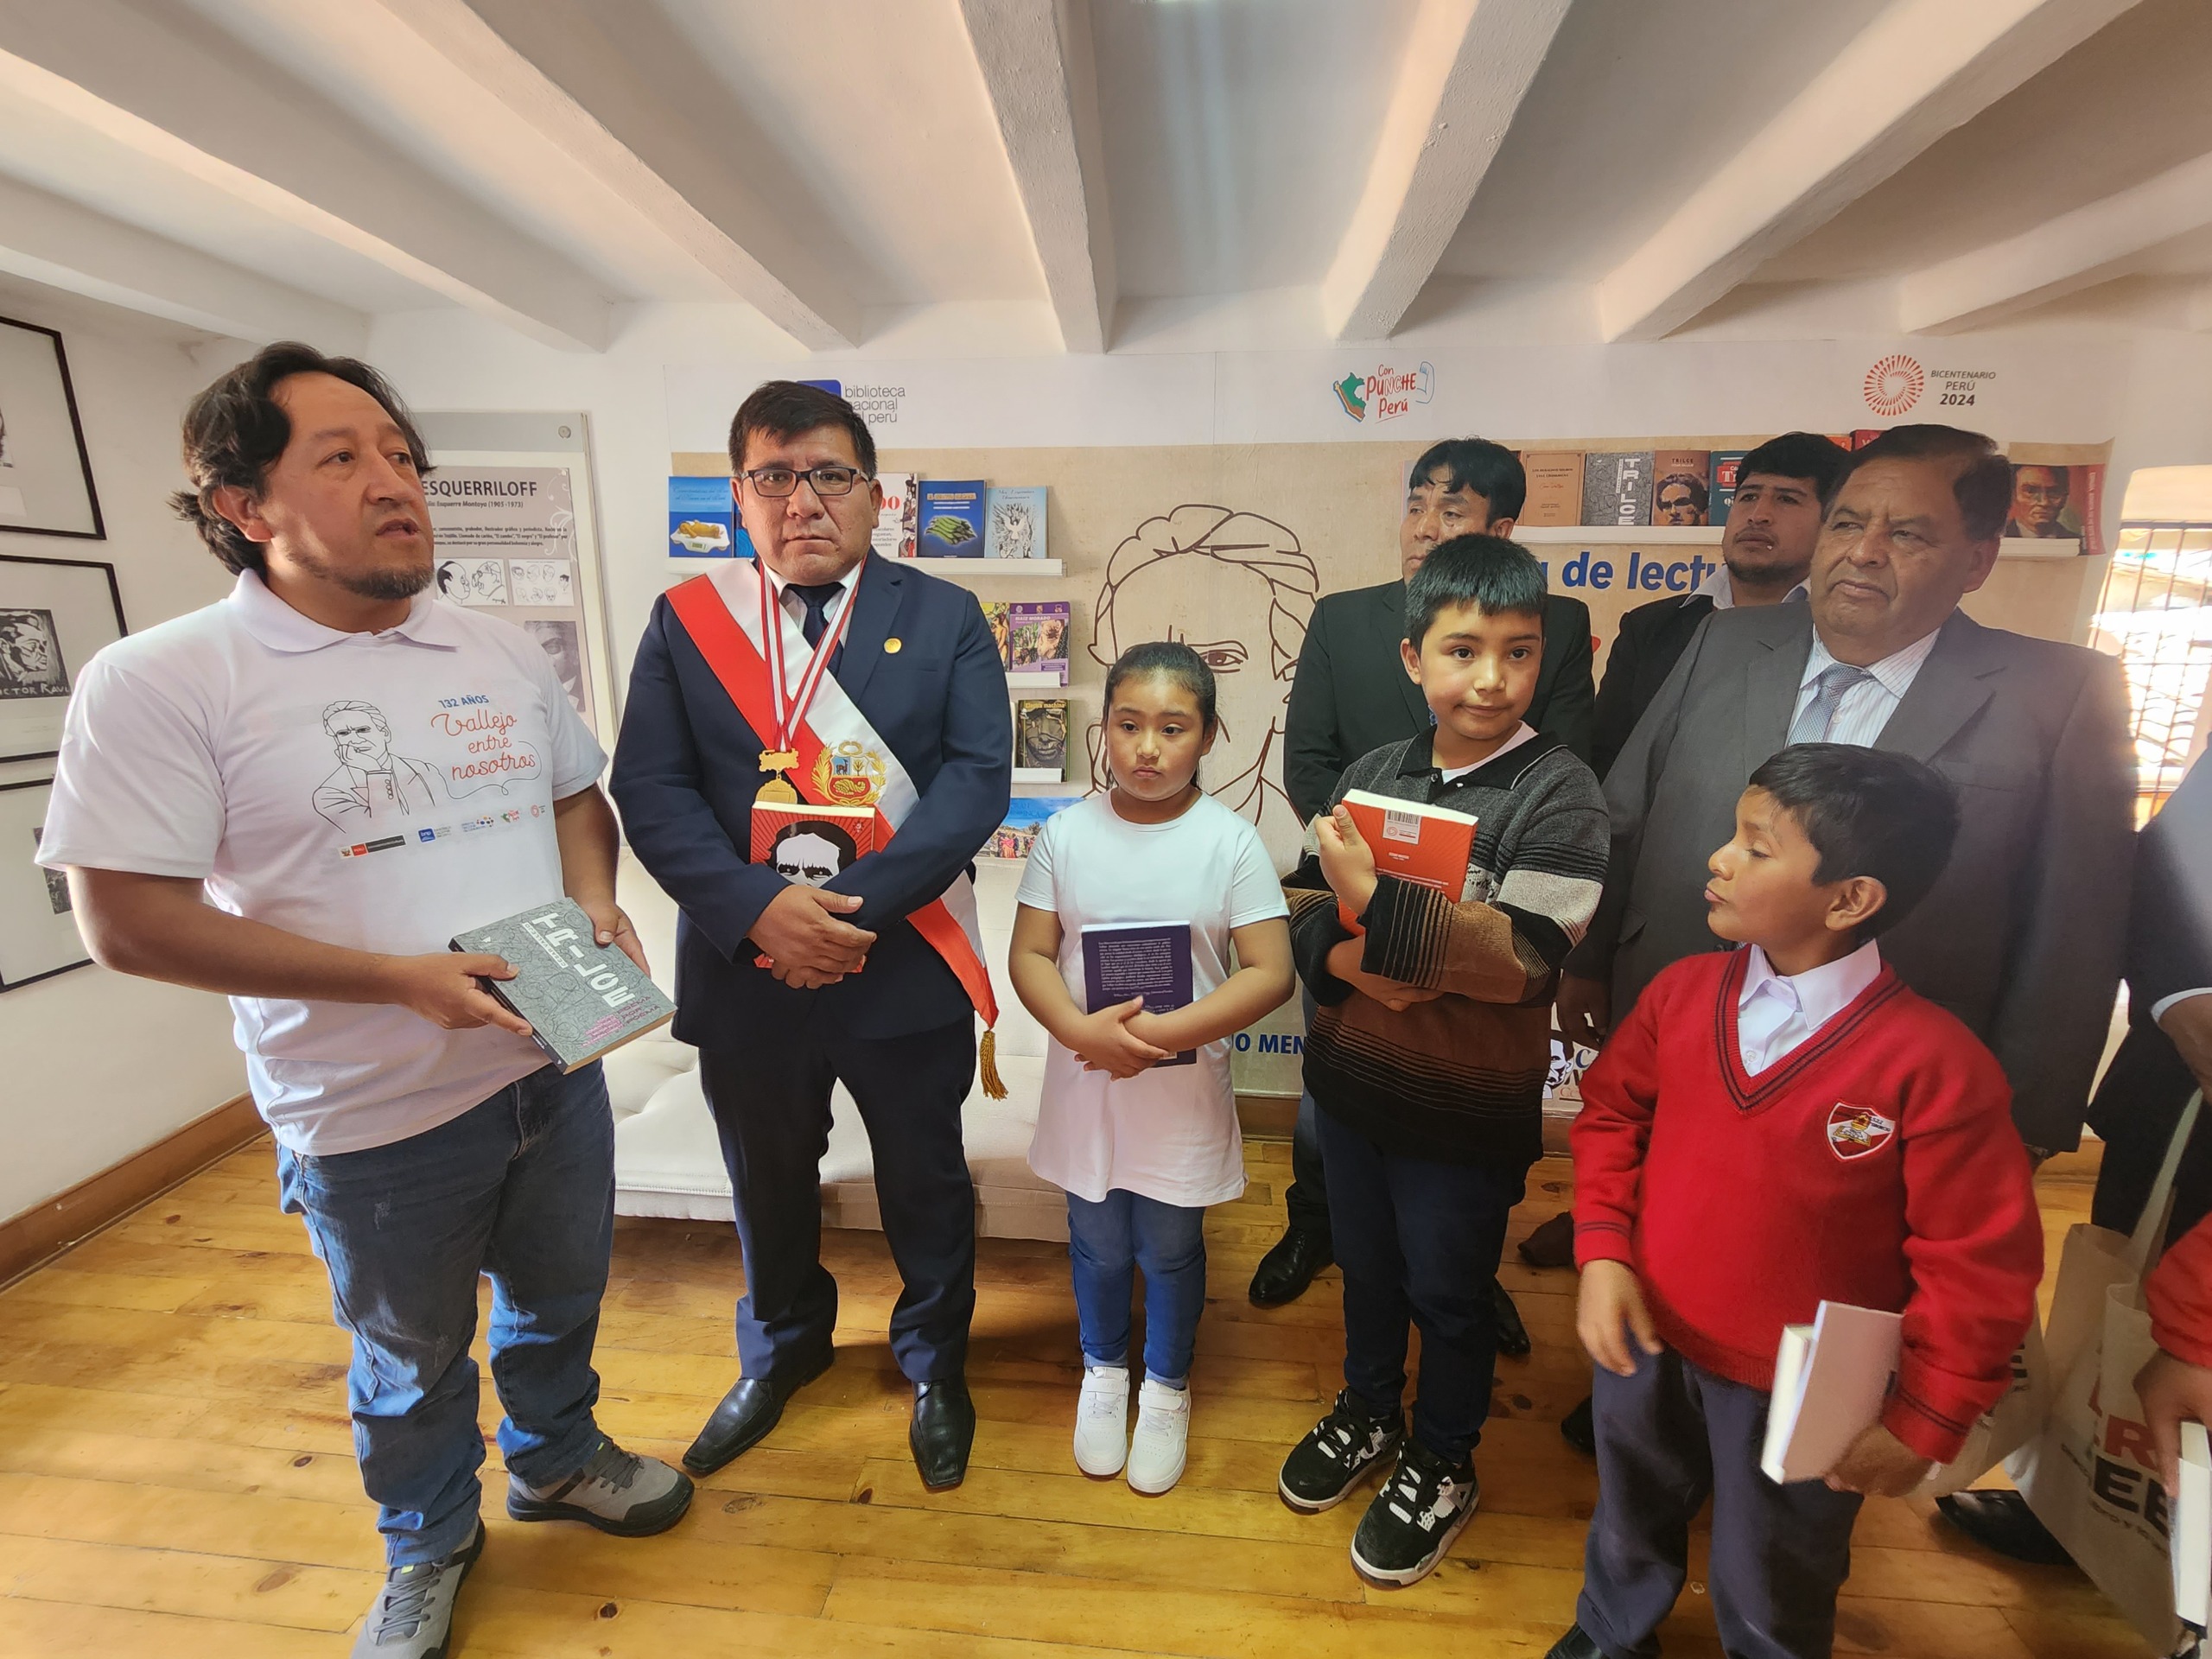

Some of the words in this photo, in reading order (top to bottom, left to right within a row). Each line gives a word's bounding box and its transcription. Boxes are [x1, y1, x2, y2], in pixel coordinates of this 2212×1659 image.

[1378, 364, 1394, 377] Con
[1930, 370, 1996, 379] BICENTENARIO
[845, 385, 906, 397] biblioteca
[1366, 372, 1417, 401] PUNCHE
[1945, 380, 1976, 391] PERÚ
[1378, 398, 1408, 418] Perú
[1939, 393, 1975, 406] 2024
[868, 410, 897, 425] perú
[422, 480, 537, 497] ESQUERRILOFF
[1618, 458, 1641, 526] TRILCE
[1561, 551, 1613, 590] de
[438, 698, 460, 709] 132
[461, 694, 490, 707] AÑOS
[430, 708, 518, 737] Vallejo
[467, 734, 512, 754] entre
[452, 752, 536, 781] nosotros
[532, 912, 635, 1007] TRILCE
